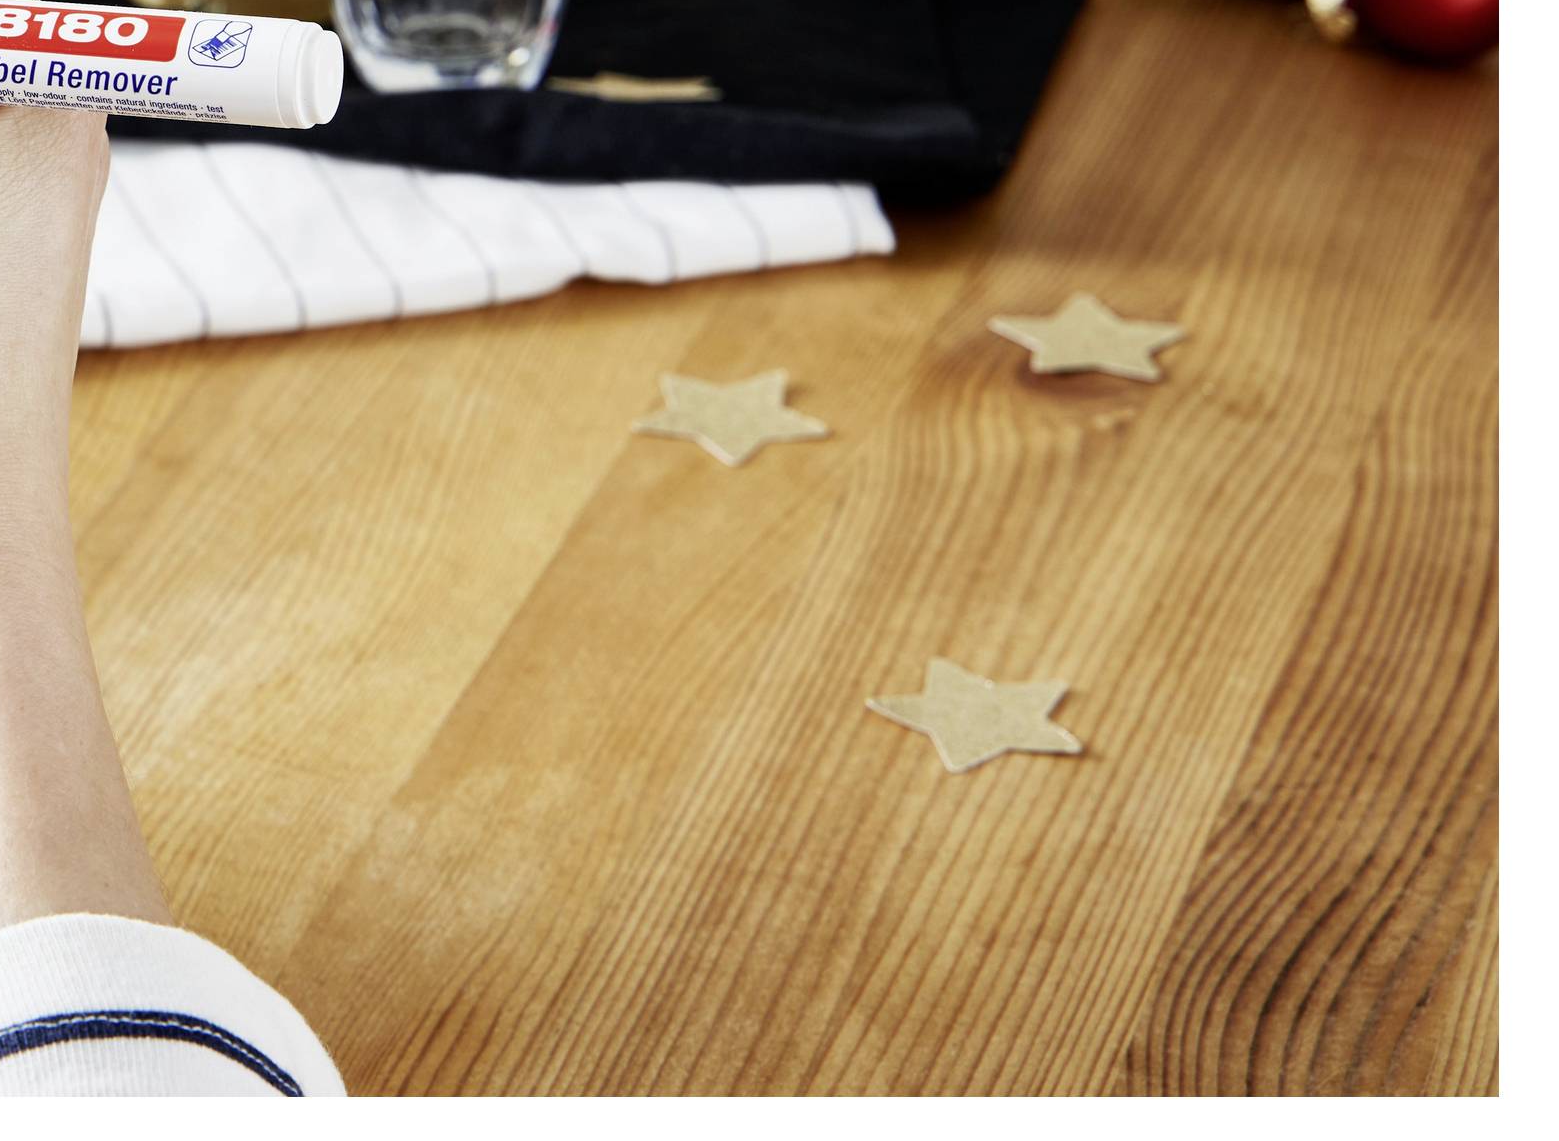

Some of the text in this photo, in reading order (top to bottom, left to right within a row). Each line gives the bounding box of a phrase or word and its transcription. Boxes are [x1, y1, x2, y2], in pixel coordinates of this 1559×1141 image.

[46, 59, 178, 96] Remover
[23, 89, 67, 101] low-odour
[76, 94, 114, 105] contains
[116, 97, 147, 108] natural
[149, 99, 198, 113] ingredients
[207, 104, 225, 114] test
[96, 103, 112, 111] und
